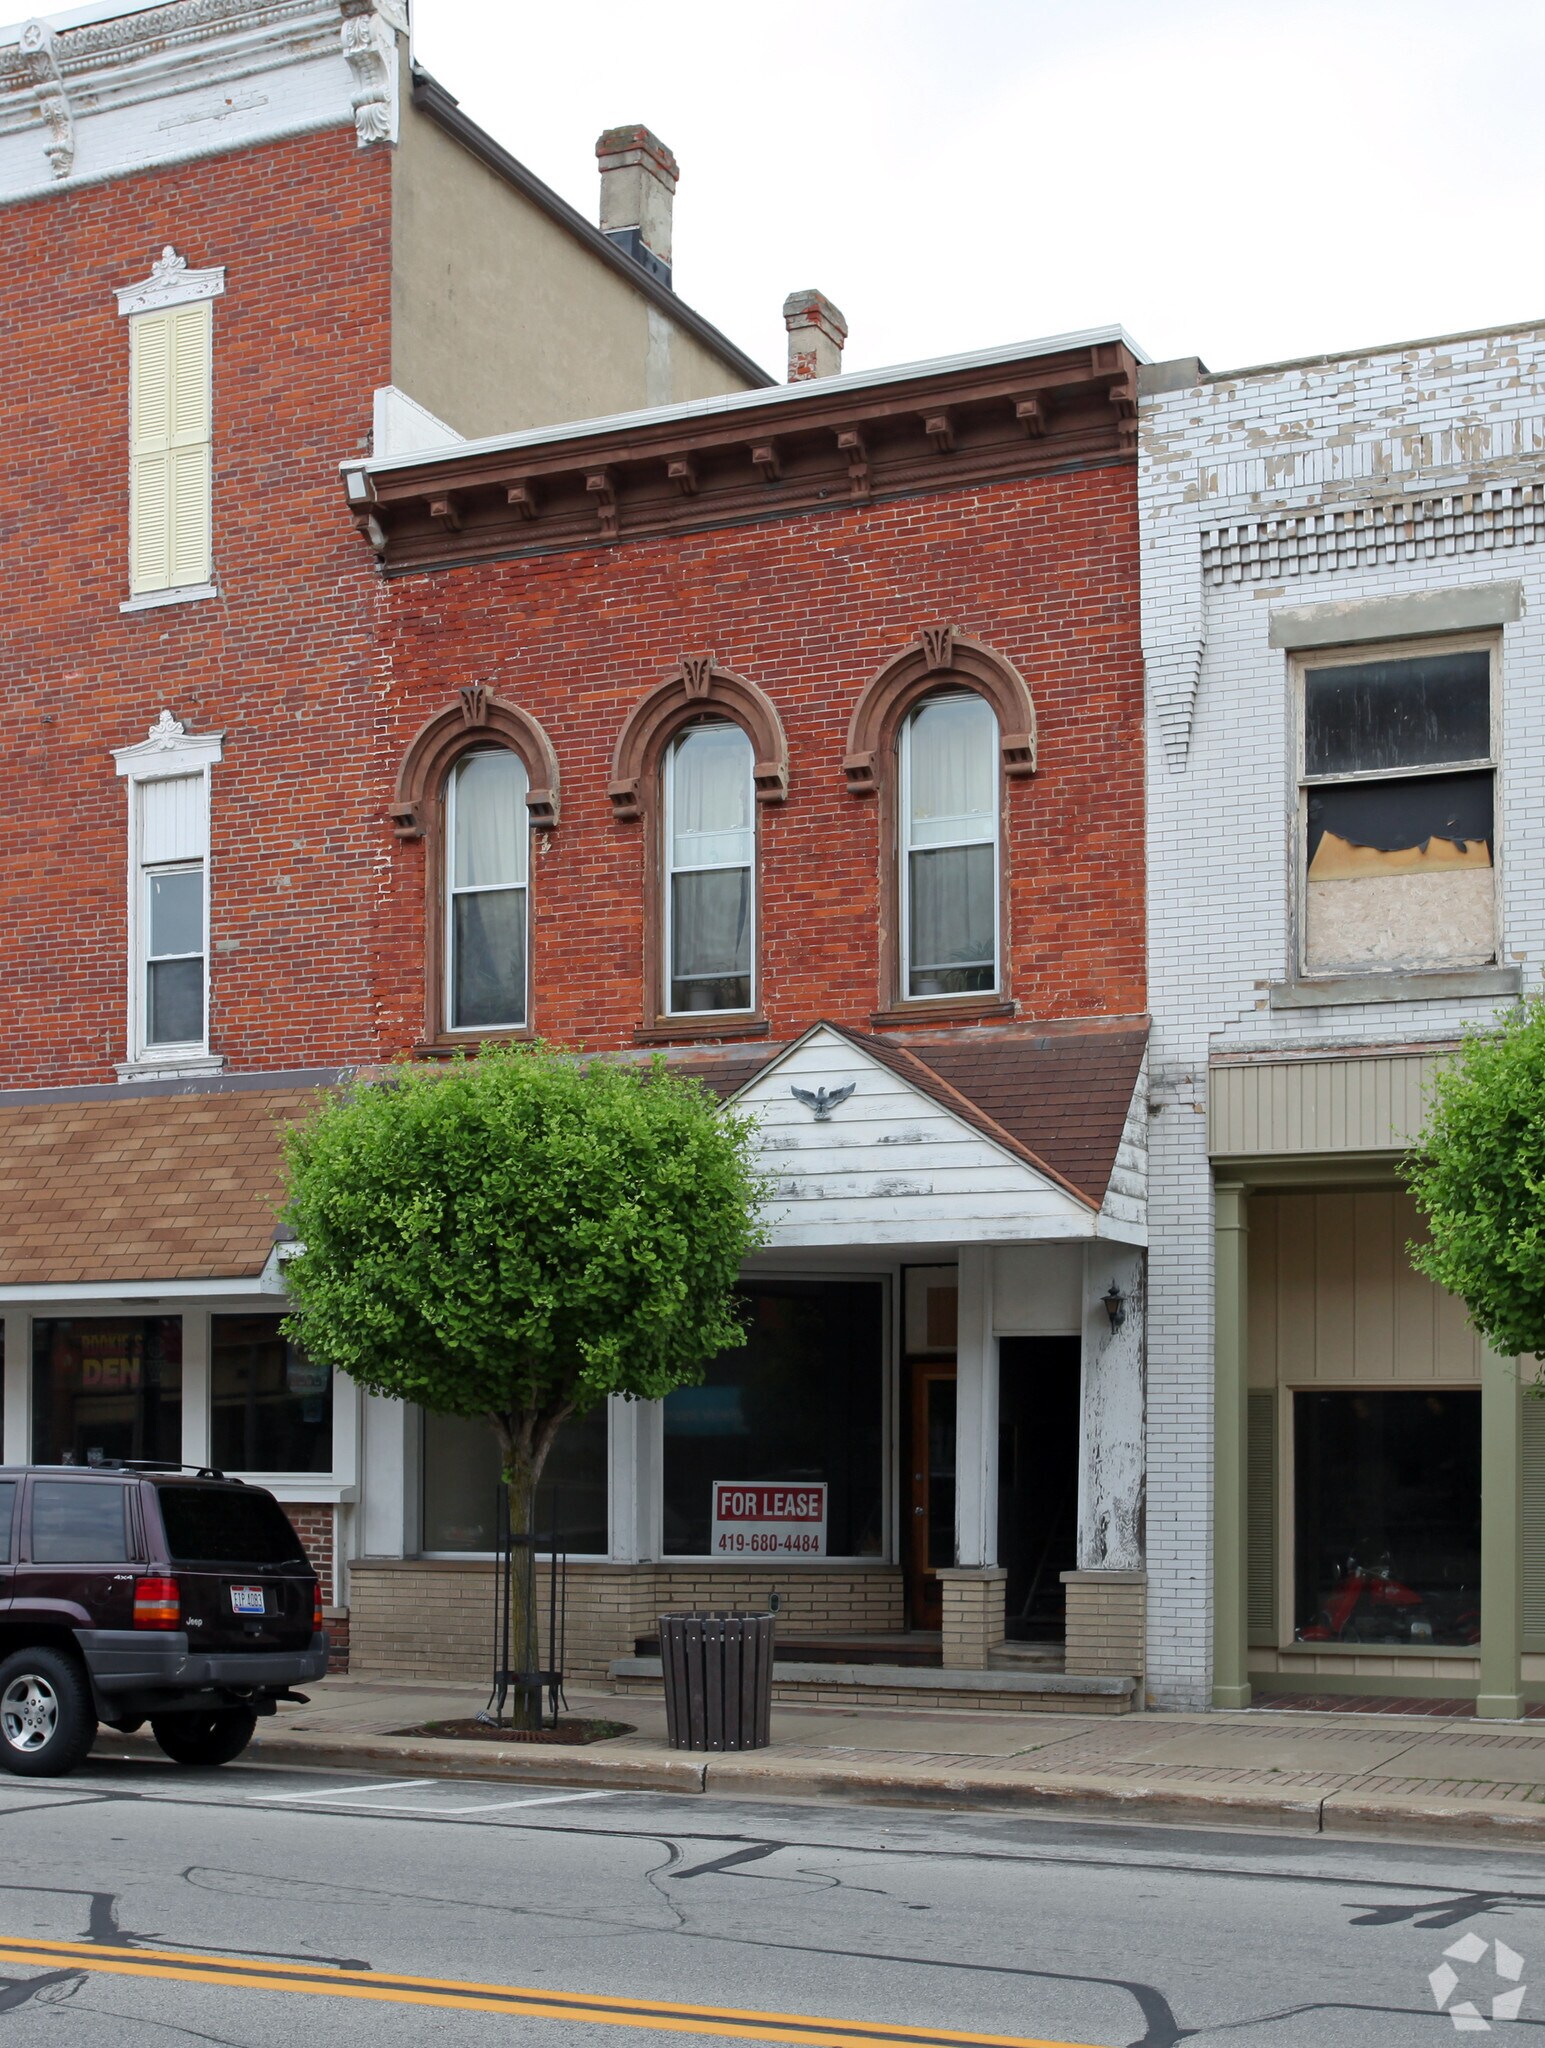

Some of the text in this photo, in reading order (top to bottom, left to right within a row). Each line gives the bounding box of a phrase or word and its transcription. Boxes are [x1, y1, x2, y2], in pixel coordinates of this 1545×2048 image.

[82, 1358, 140, 1386] DEN
[721, 1492, 819, 1517] FOR LEASE
[718, 1533, 820, 1552] 419-680-4484
[186, 1616, 203, 1627] Jeep
